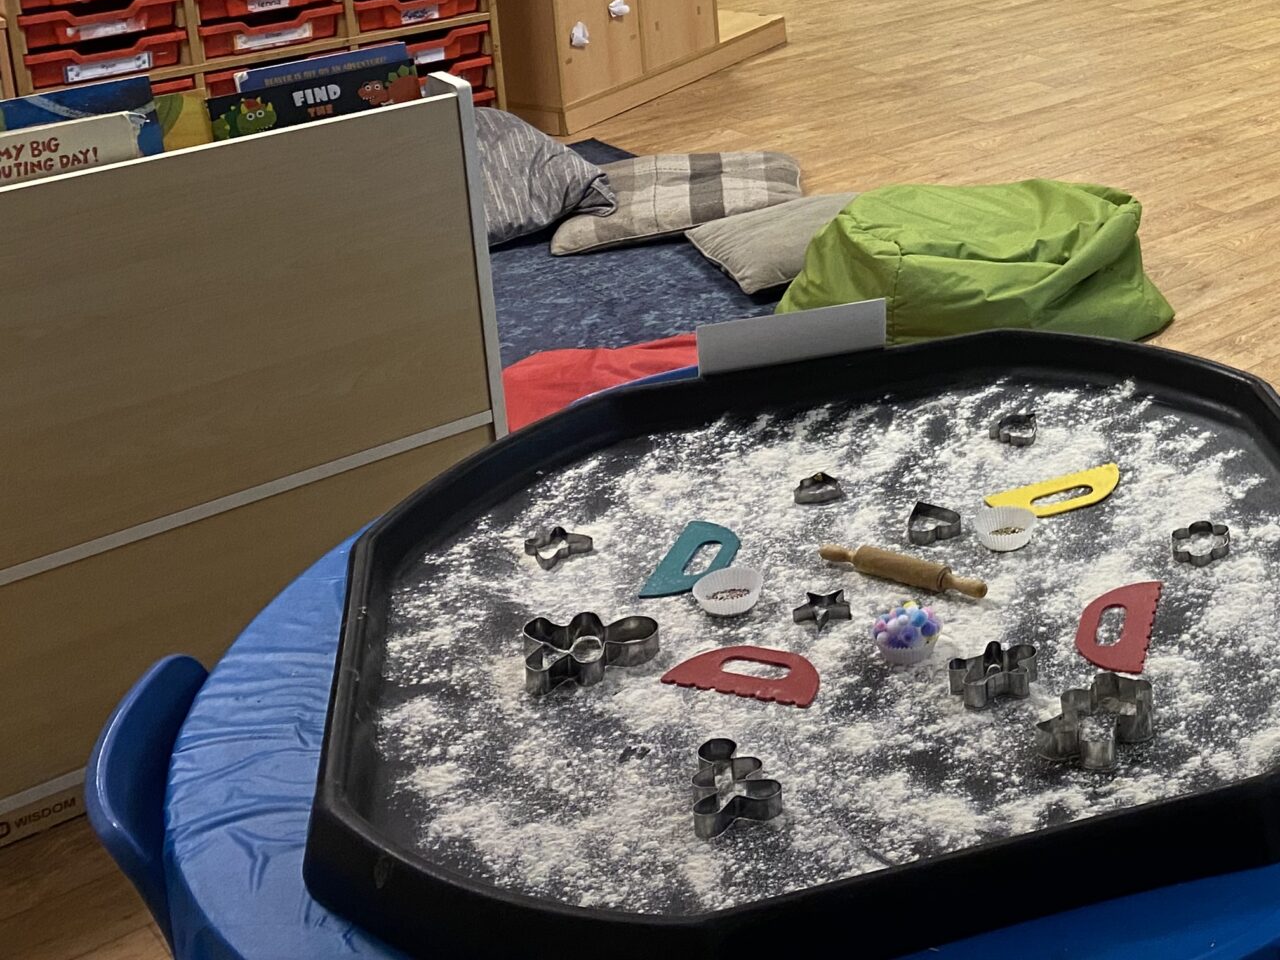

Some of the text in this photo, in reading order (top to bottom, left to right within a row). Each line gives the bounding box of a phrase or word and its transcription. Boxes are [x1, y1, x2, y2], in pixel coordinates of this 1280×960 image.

[292, 84, 341, 107] FIND
[307, 104, 334, 117] THE
[0, 137, 60, 161] MY BIG
[0, 147, 98, 178] UTING DAY!
[14, 797, 76, 828] WISDOM
